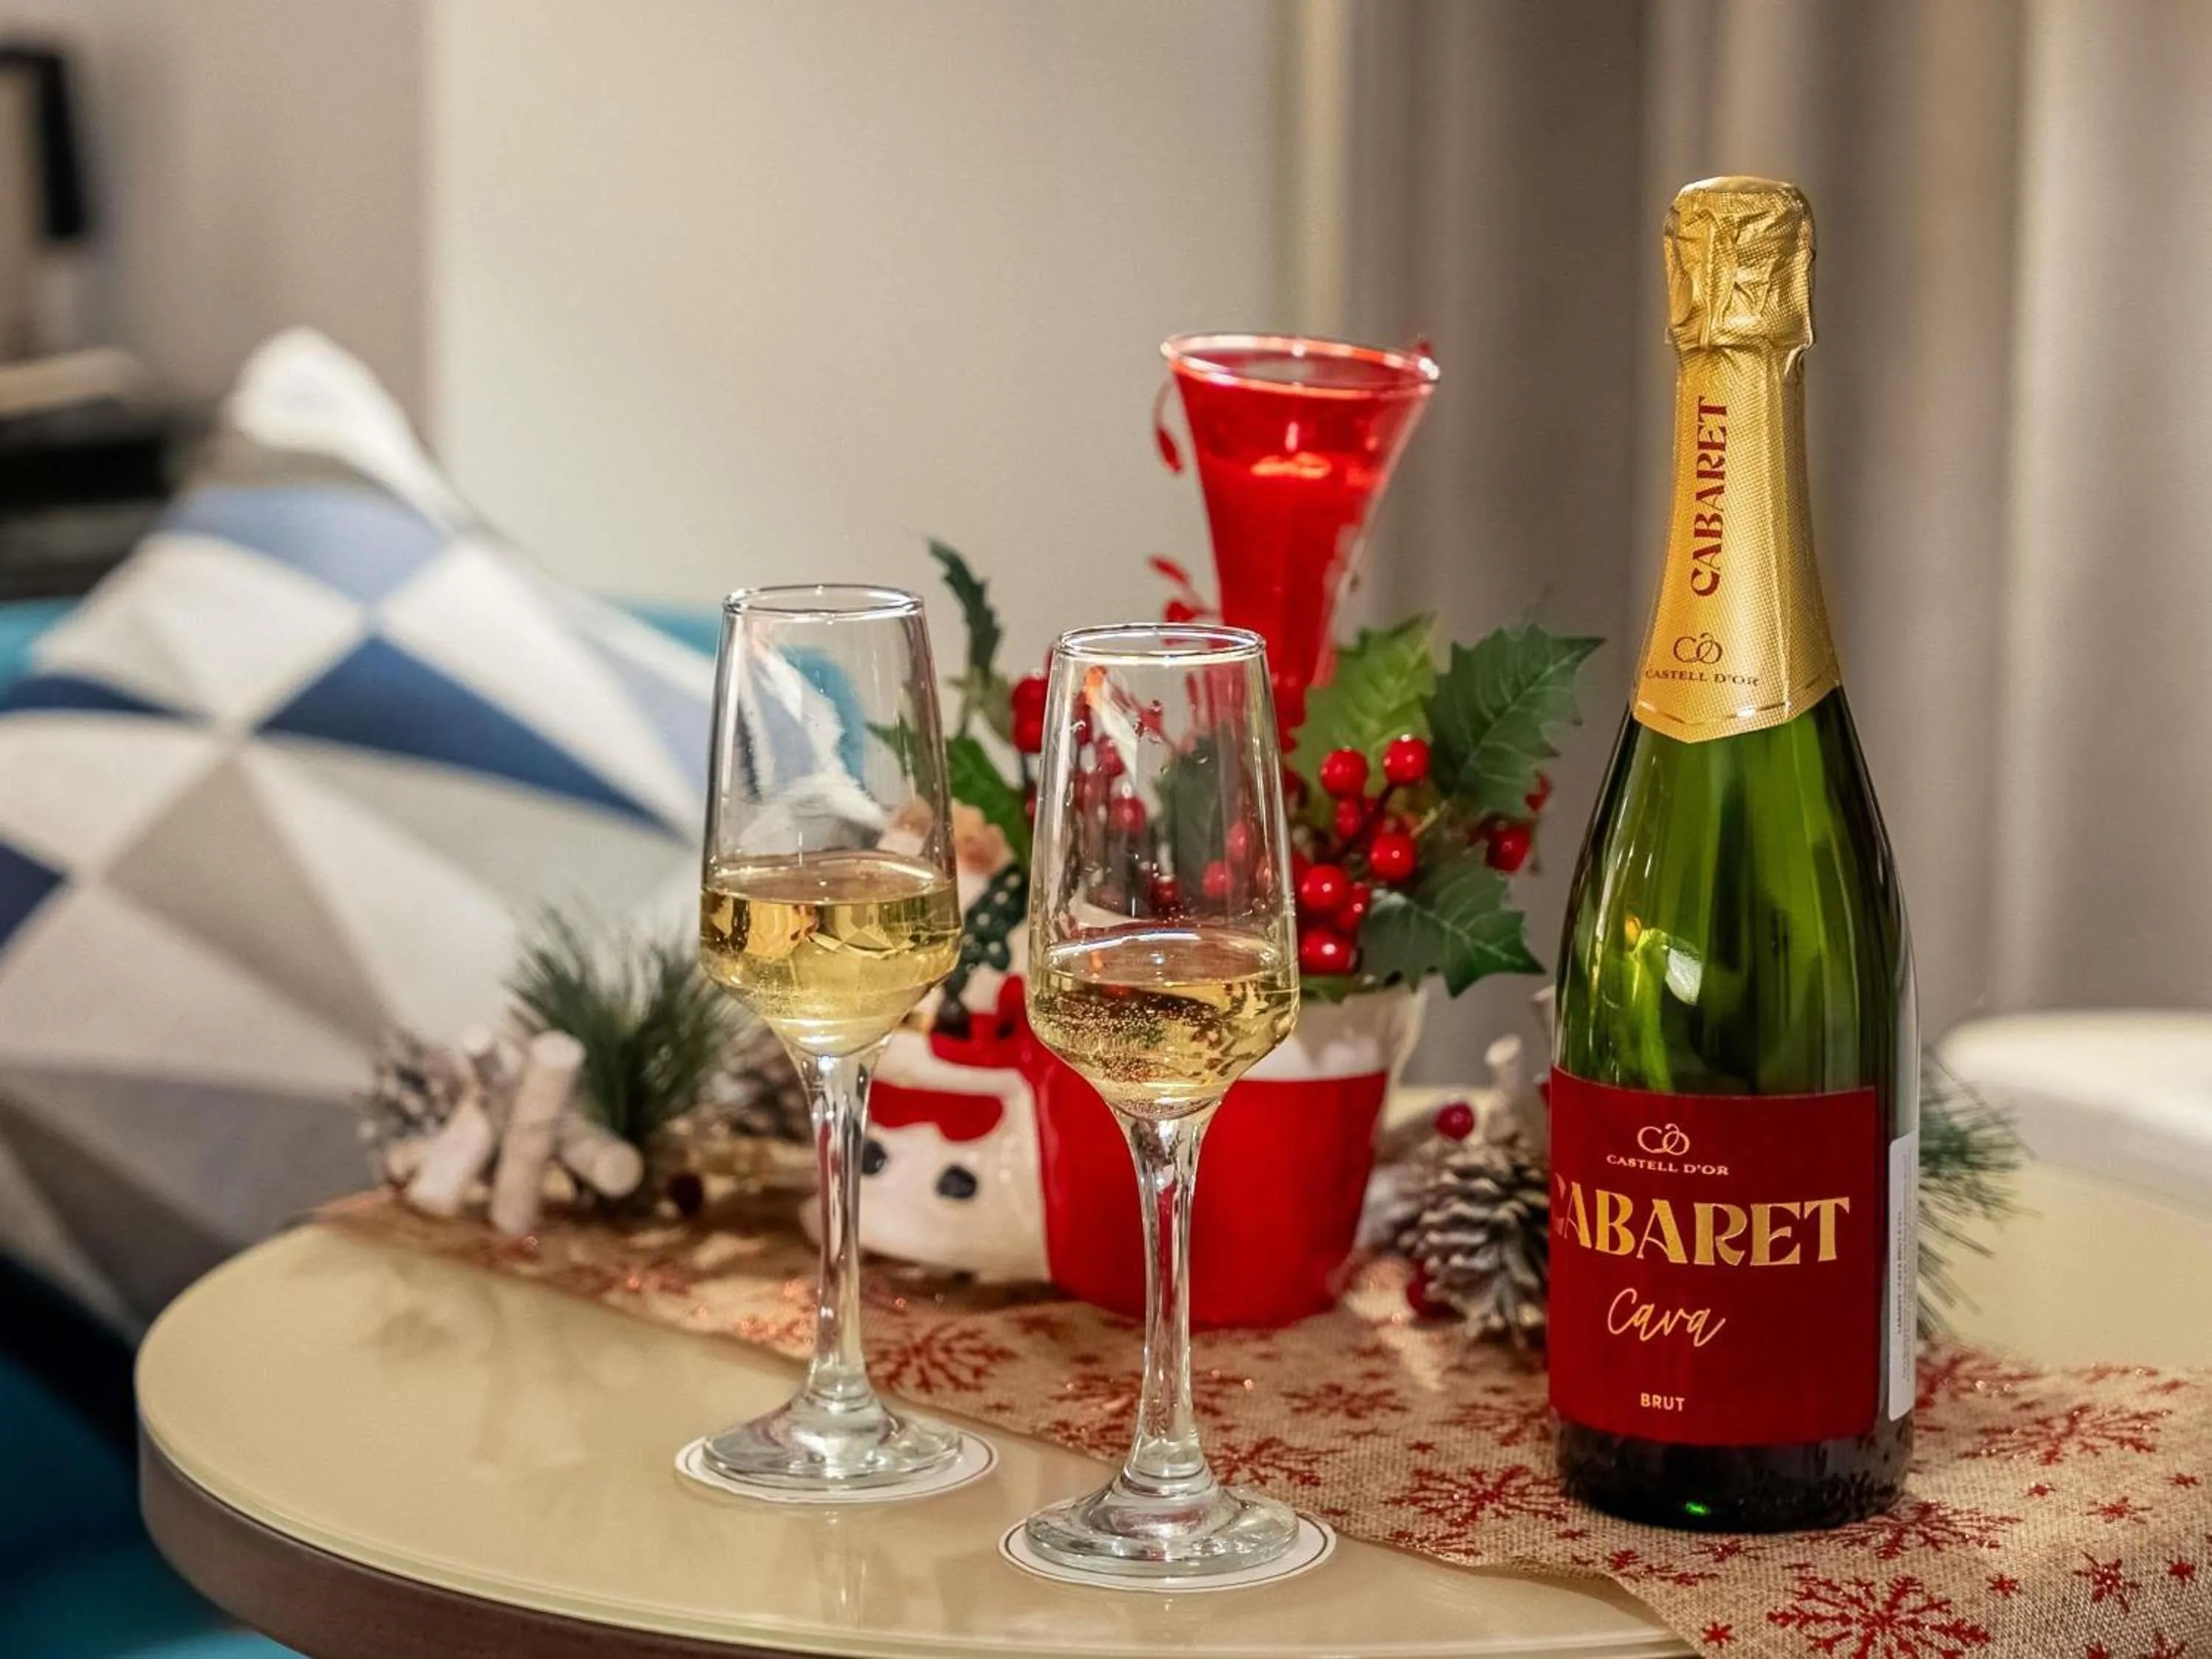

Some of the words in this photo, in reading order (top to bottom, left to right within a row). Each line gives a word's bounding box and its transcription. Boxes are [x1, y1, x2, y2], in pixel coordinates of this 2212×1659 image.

[1691, 394, 1727, 597] CABARET
[1645, 668, 1708, 682] CASTELL
[1714, 673, 1759, 686] D'OR
[1606, 1154, 1679, 1173] CASTELL
[1683, 1164, 1729, 1175] D'OR
[1607, 1287, 1726, 1347] Cava
[1641, 1392, 1686, 1411] BRUT
